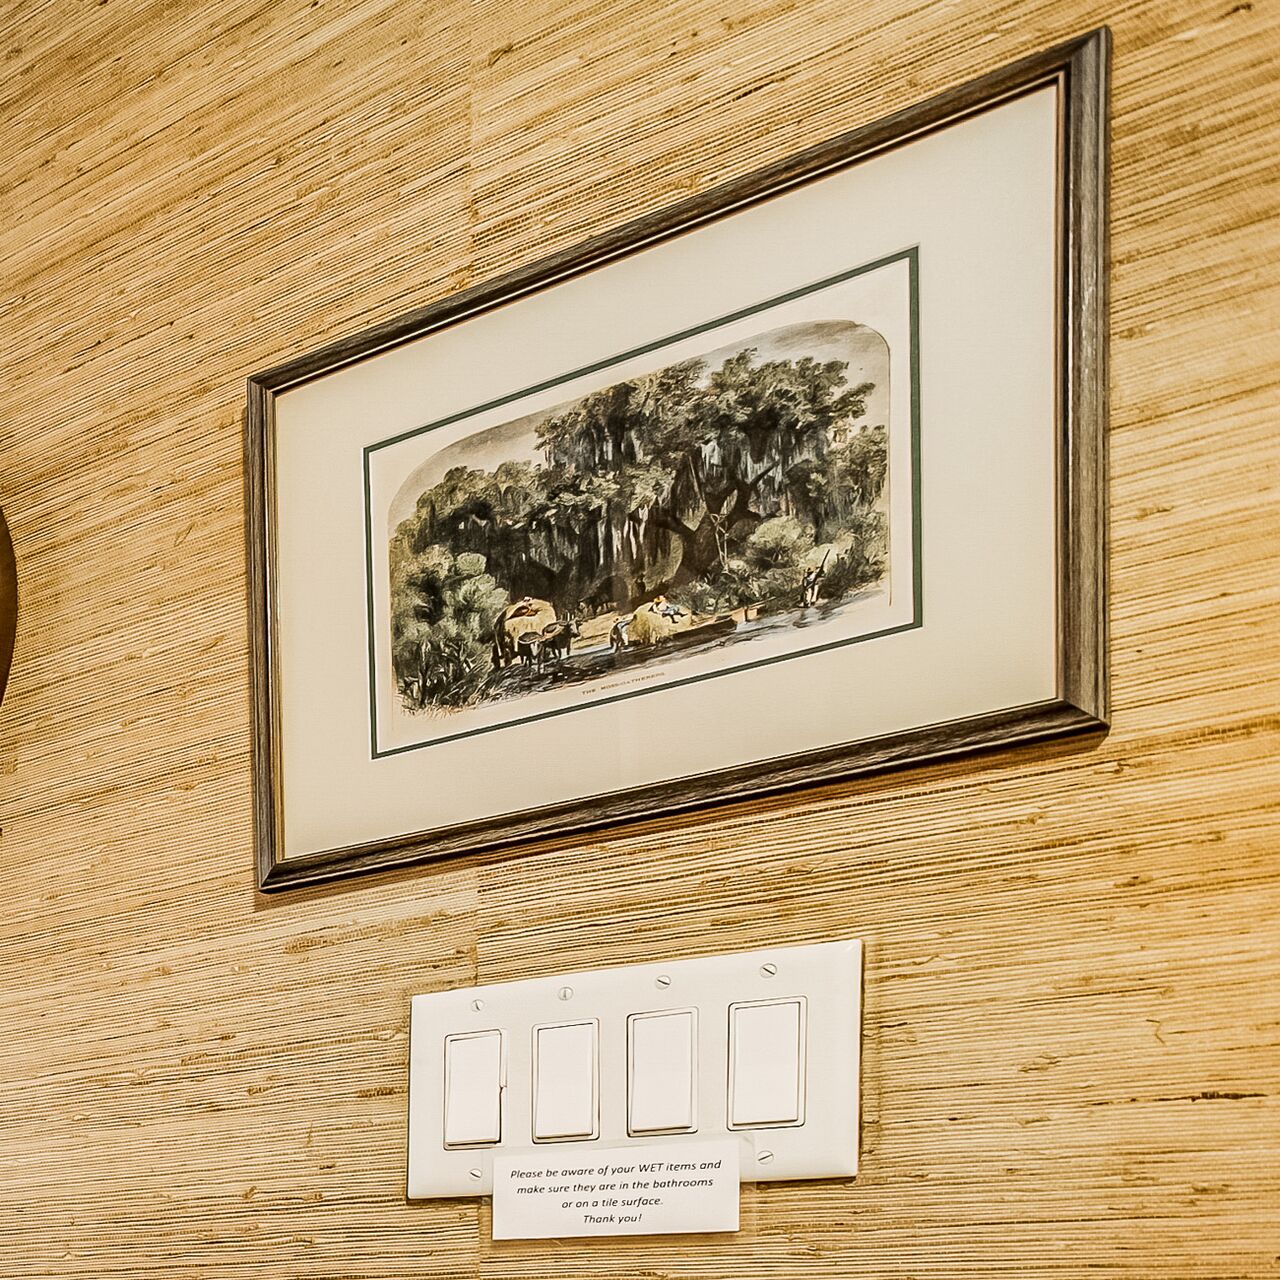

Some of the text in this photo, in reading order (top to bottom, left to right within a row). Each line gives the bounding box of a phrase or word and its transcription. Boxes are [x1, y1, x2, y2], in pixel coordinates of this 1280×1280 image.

[510, 1160, 722, 1178] Please be aware of your WET items and
[516, 1178, 714, 1194] make sure they are in the bathrooms
[561, 1197, 663, 1209] or on a tile surface.
[583, 1214, 642, 1225] Thank you!
